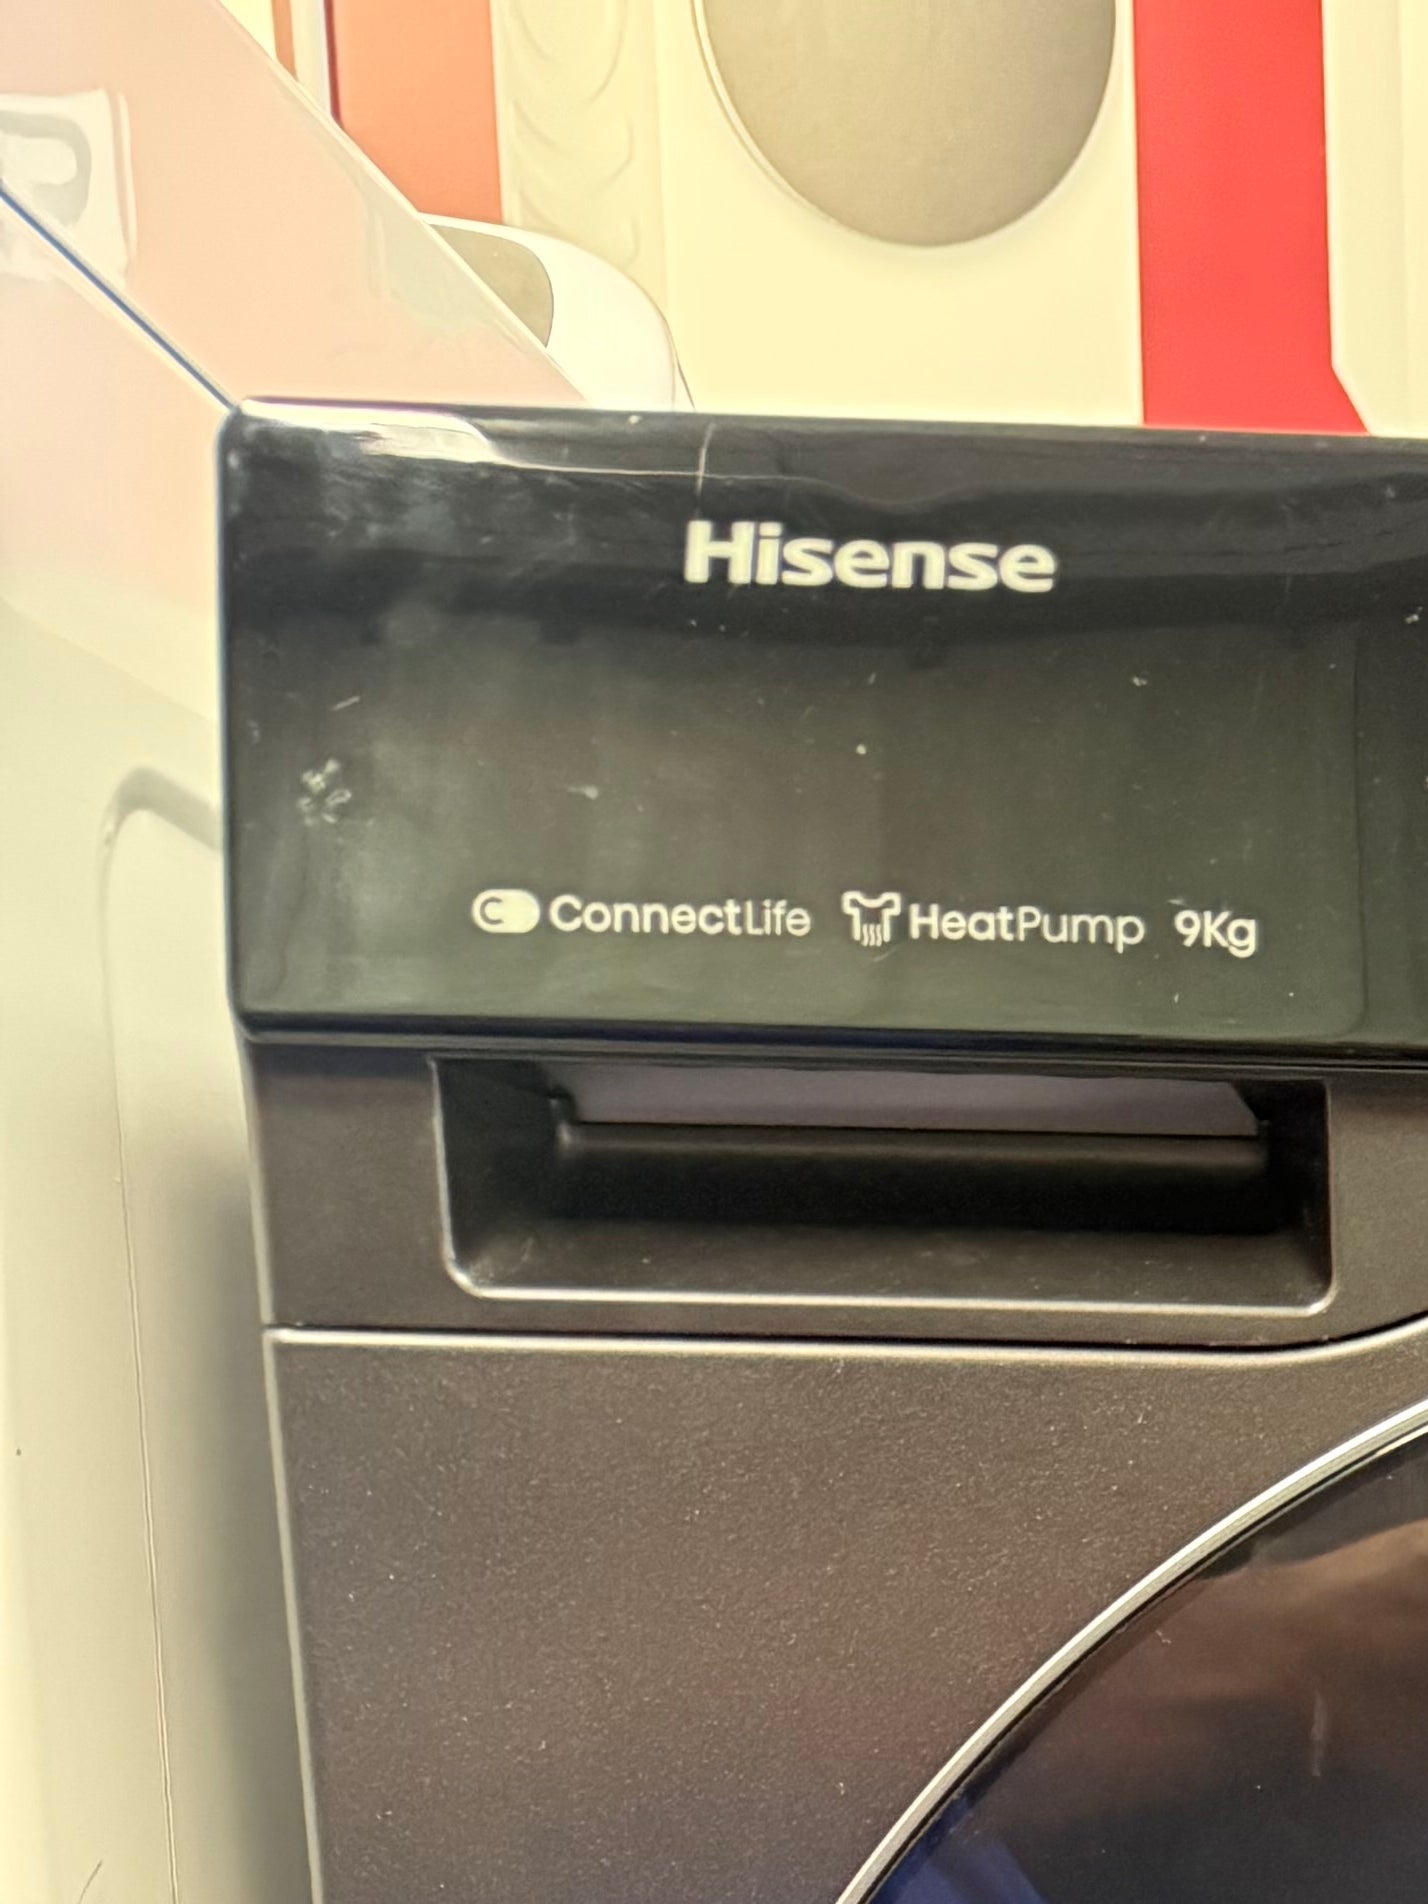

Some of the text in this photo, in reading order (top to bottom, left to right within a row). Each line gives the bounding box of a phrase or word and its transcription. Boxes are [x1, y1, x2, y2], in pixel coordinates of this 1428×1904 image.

[684, 520, 1058, 592] Hisense
[548, 894, 1258, 958] ConnectLife HeatPump 9Kg
